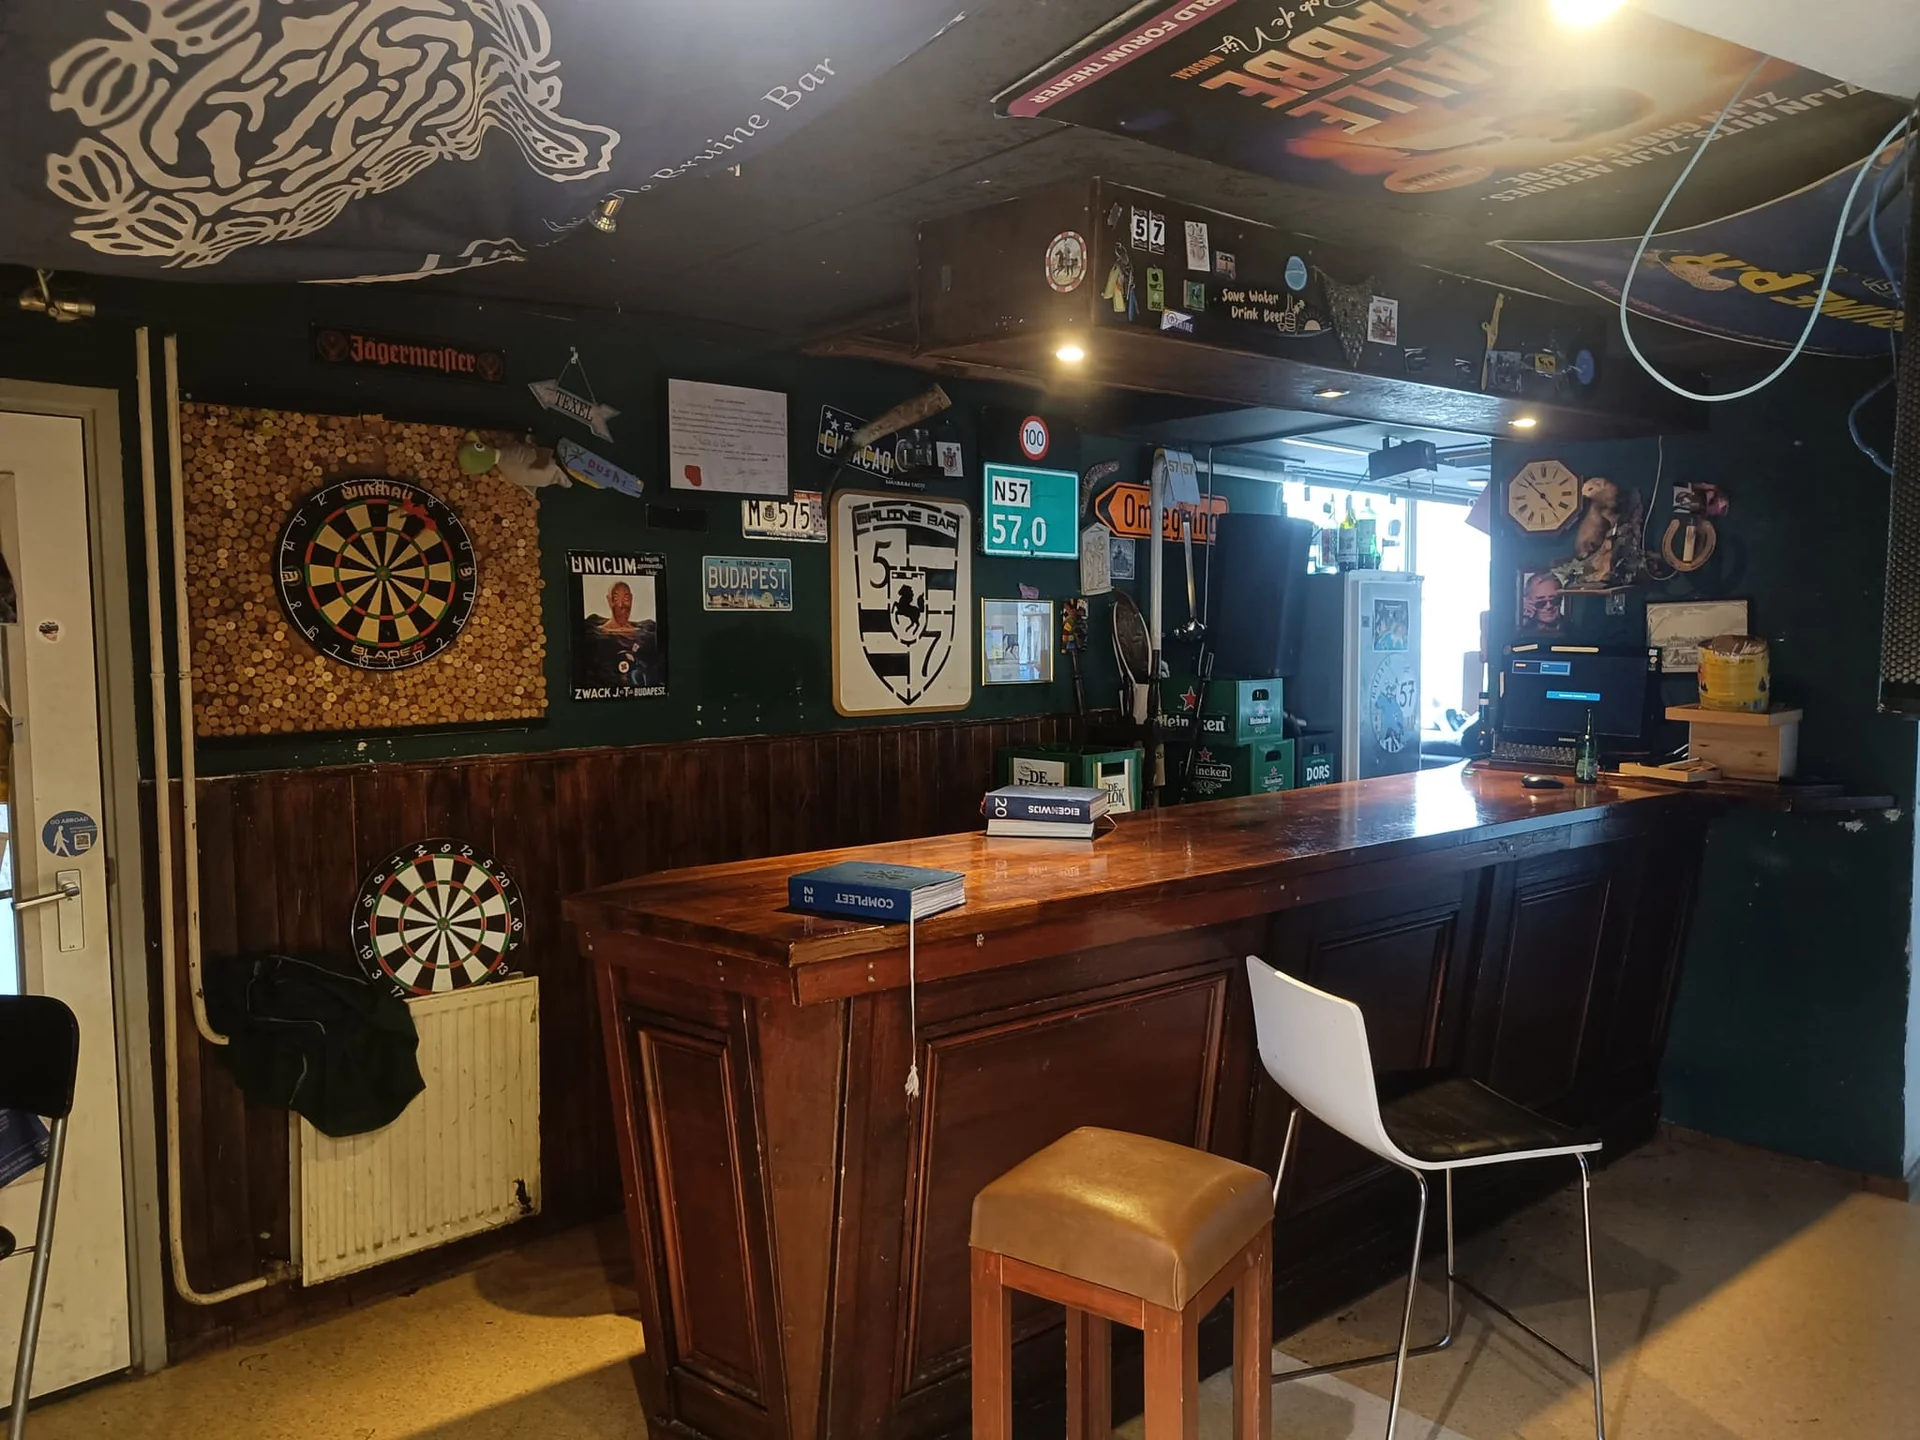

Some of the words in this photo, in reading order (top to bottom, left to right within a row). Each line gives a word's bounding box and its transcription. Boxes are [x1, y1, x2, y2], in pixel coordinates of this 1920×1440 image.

[1174, 0, 1224, 20] RLD
[1101, 21, 1178, 63] FORUM
[1169, 54, 1226, 81] MUSICAL
[1029, 62, 1109, 104] THEATER
[1775, 82, 1866, 116] ZIJN
[651, 112, 770, 180] Bruine
[761, 57, 838, 111] Bar
[1599, 121, 1704, 154] GROTE
[1612, 140, 1690, 168] ZIJN
[1494, 153, 1603, 187] LIEFDE.
[1480, 163, 1615, 202] AFFAIRES.
[1136, 219, 1145, 238] 5
[1154, 223, 1163, 242] 7
[1222, 288, 1245, 303] Save
[1249, 290, 1279, 305] Water
[1231, 306, 1259, 320] Drink
[1263, 310, 1285, 324] Beer
[556, 390, 593, 422] TEXEL
[1025, 429, 1045, 447] 100
[994, 480, 1029, 503] N57
[749, 498, 760, 527] M
[779, 501, 811, 530] 575
[856, 508, 922, 526] BRUINE
[927, 513, 958, 533] BAR
[992, 513, 1047, 550] 57,0
[571, 556, 637, 574] UNICUM
[869, 540, 892, 589] 5
[708, 566, 787, 590] BUDAPEST
[921, 630, 943, 678] 7
[574, 687, 611, 700] ZWACK
[1399, 680, 1416, 708] 57
[1030, 770, 1048, 785] DE
[1195, 765, 1228, 778] ineken
[1306, 764, 1330, 782] DORS
[1108, 783, 1120, 793] DE
[994, 797, 1008, 817] 20
[414, 844, 428, 858] 14
[440, 843, 452, 853] 9
[460, 844, 474, 859] 12
[391, 855, 404, 870] 11
[482, 858, 494, 870] 5
[373, 873, 386, 885] 8
[495, 871, 511, 888] 20
[362, 893, 376, 908] 16
[509, 897, 518, 906] 1
[803, 886, 814, 903] 25
[835, 893, 895, 910] COMPLEET
[357, 921, 369, 931] 7
[511, 917, 524, 932] 18
[359, 944, 374, 960] 19
[508, 941, 518, 951] 4
[371, 968, 383, 980] 3
[496, 961, 509, 976] 13
[390, 985, 405, 999] 17
